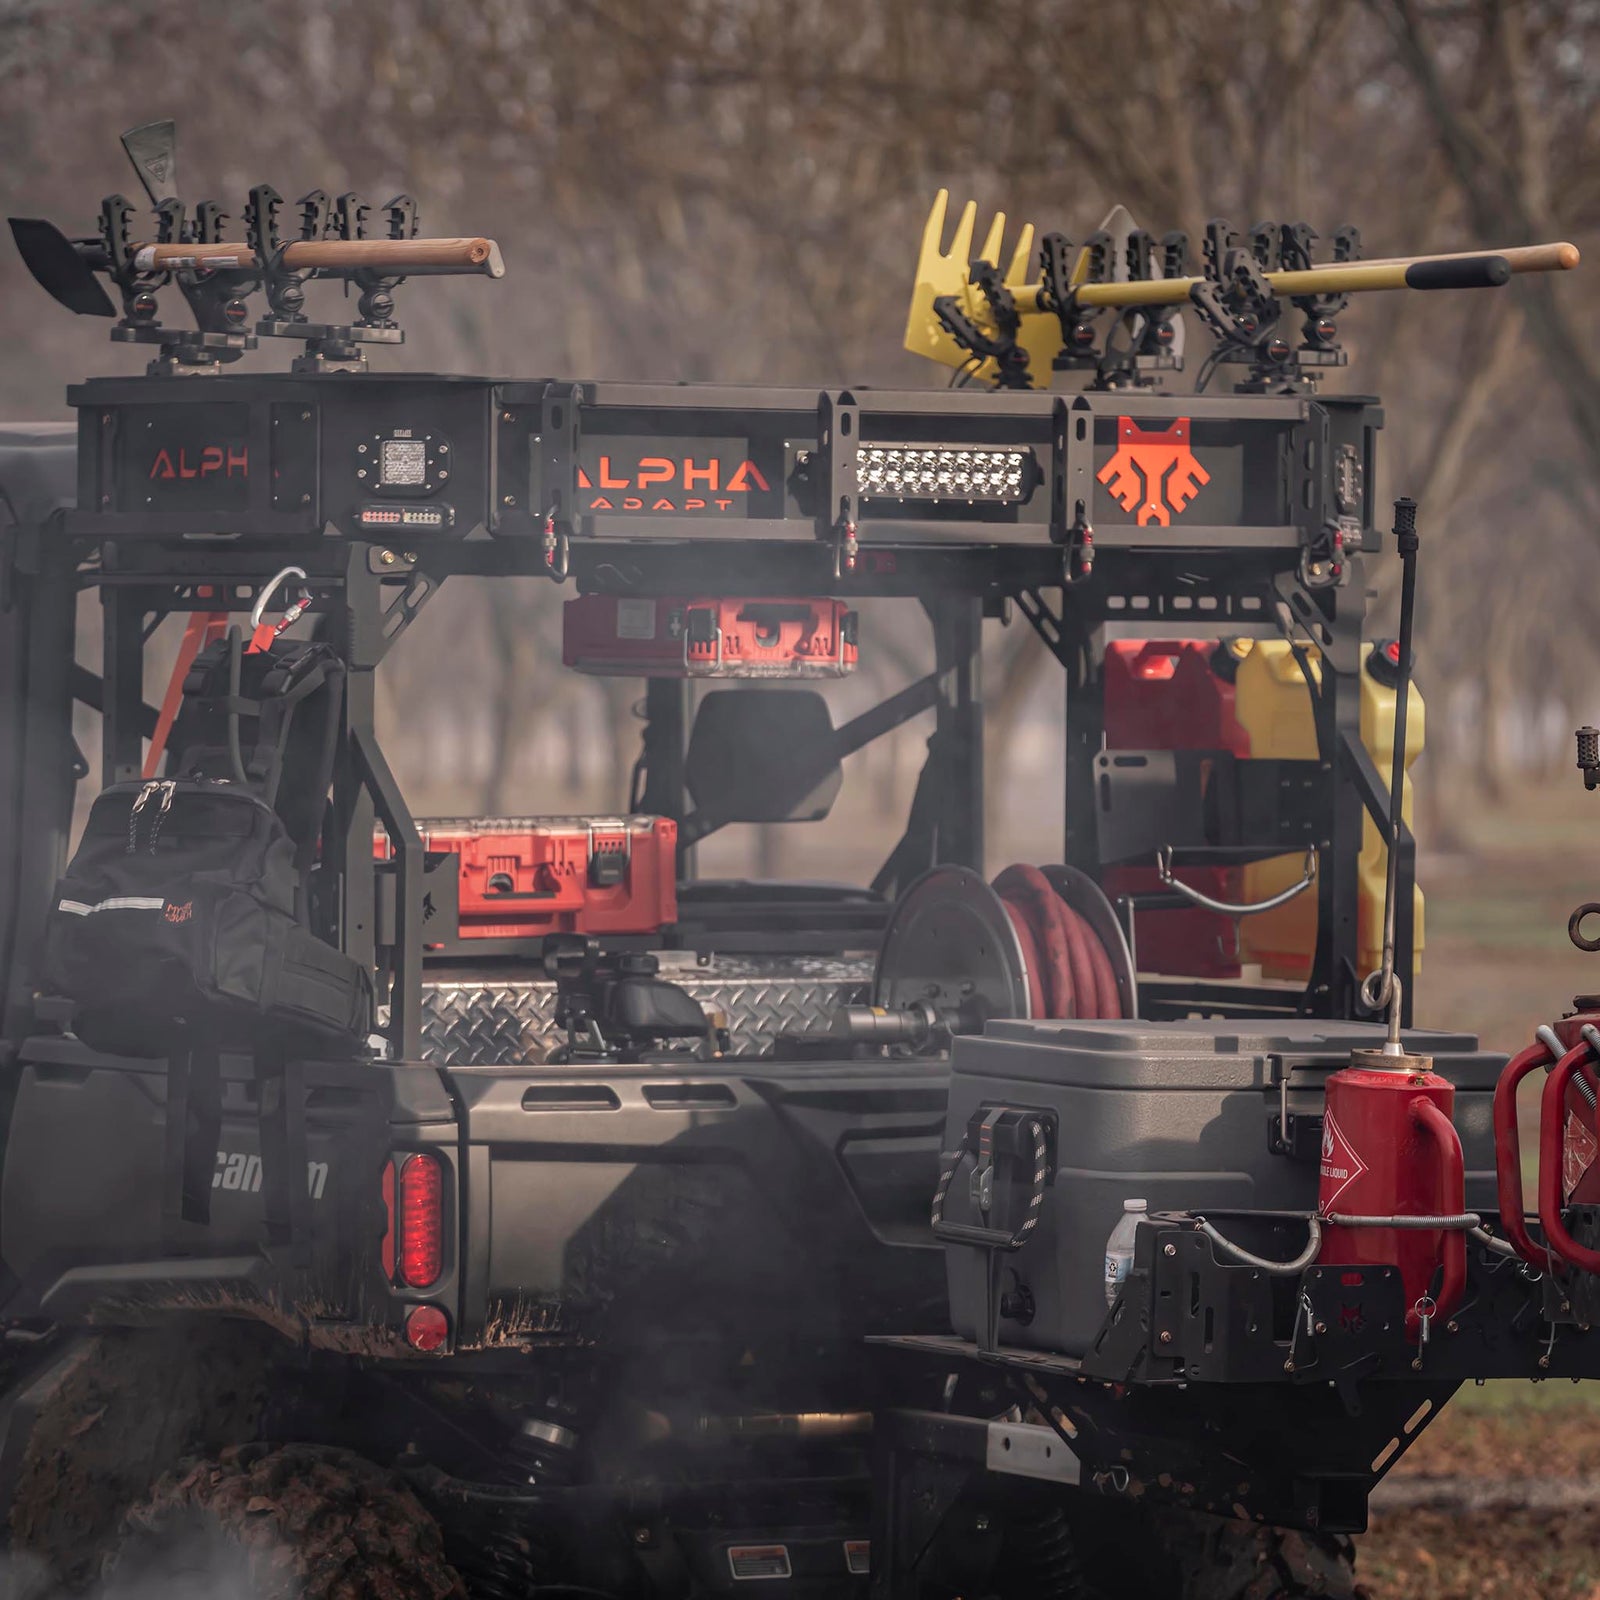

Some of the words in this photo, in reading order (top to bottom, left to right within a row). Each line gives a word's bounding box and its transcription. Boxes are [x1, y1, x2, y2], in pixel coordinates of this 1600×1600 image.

[150, 446, 280, 480] ALPH
[590, 497, 733, 511] ADAPT
[1330, 1167, 1348, 1179] LIQUID
